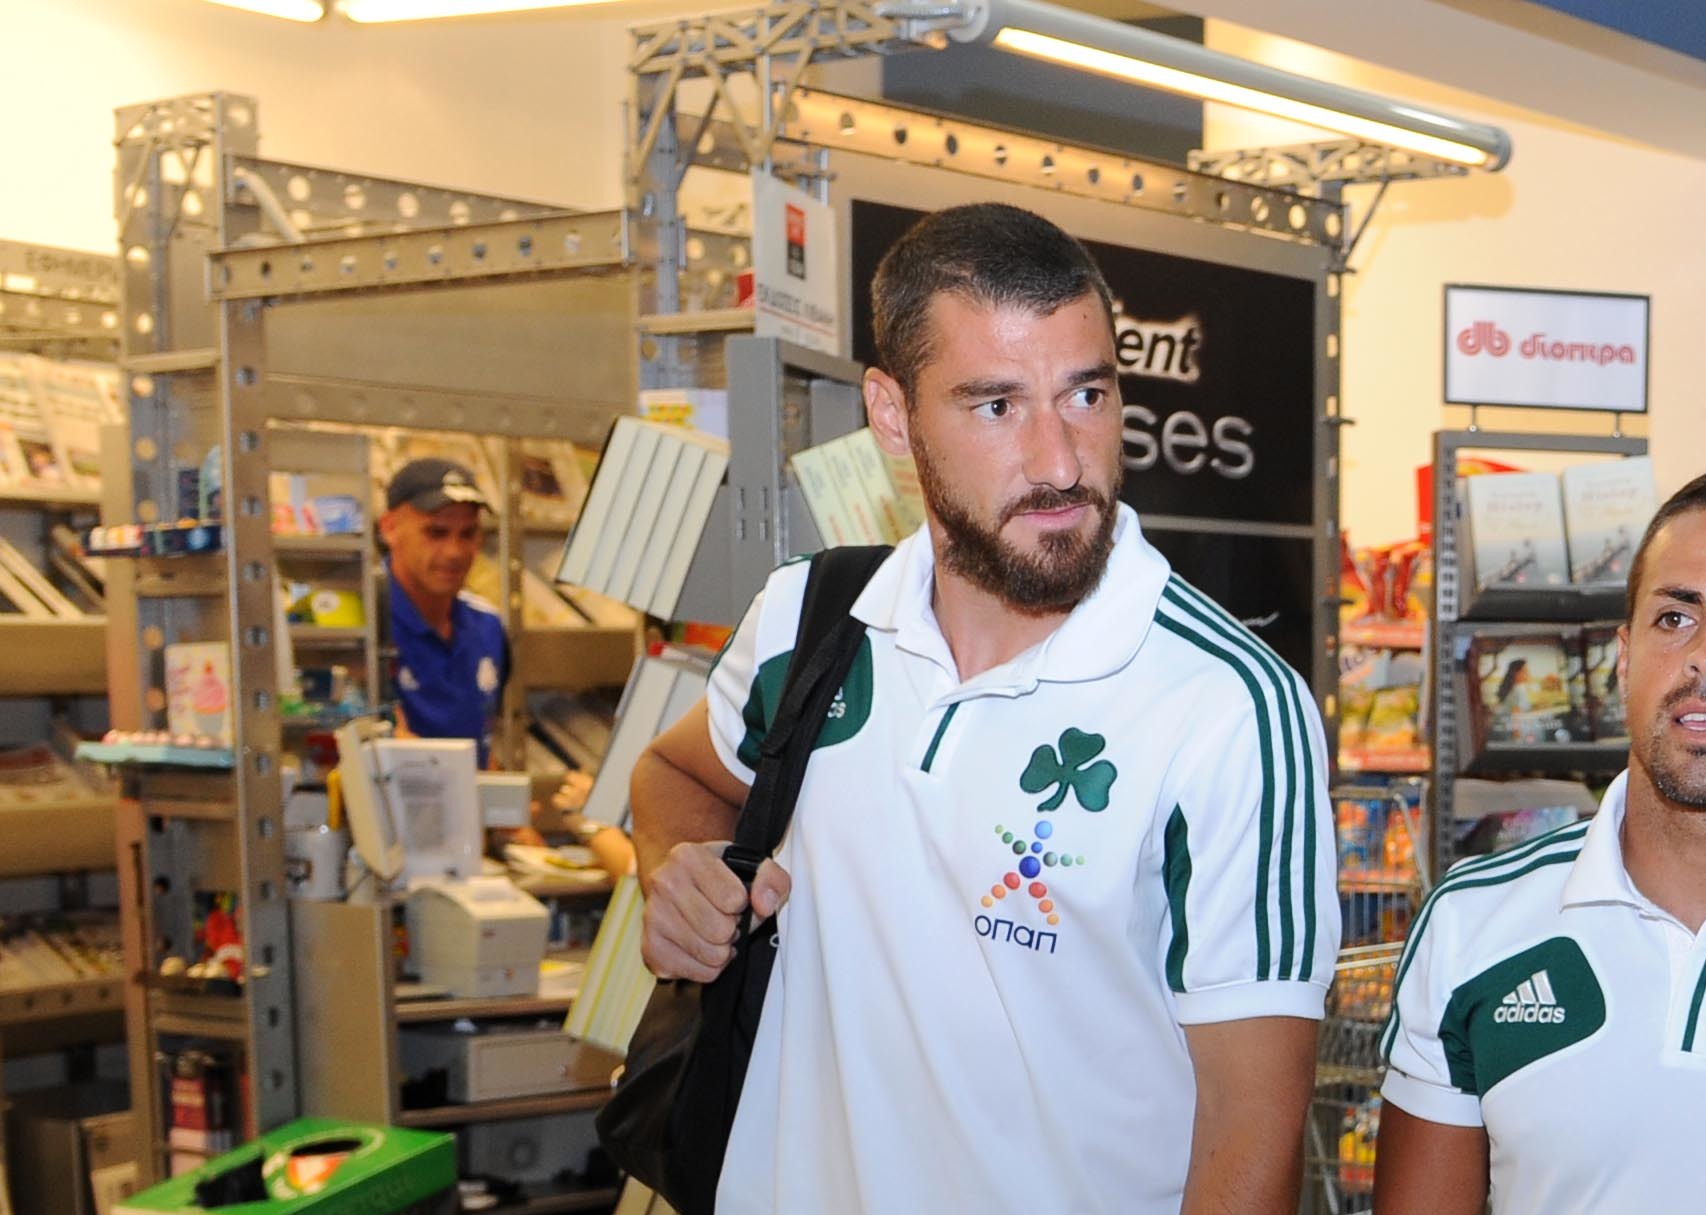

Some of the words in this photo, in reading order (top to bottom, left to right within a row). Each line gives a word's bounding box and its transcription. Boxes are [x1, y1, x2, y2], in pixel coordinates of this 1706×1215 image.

[1115, 325, 1200, 375] ent
[1122, 404, 1254, 480] ses
[1494, 1001, 1565, 1023] adidas
